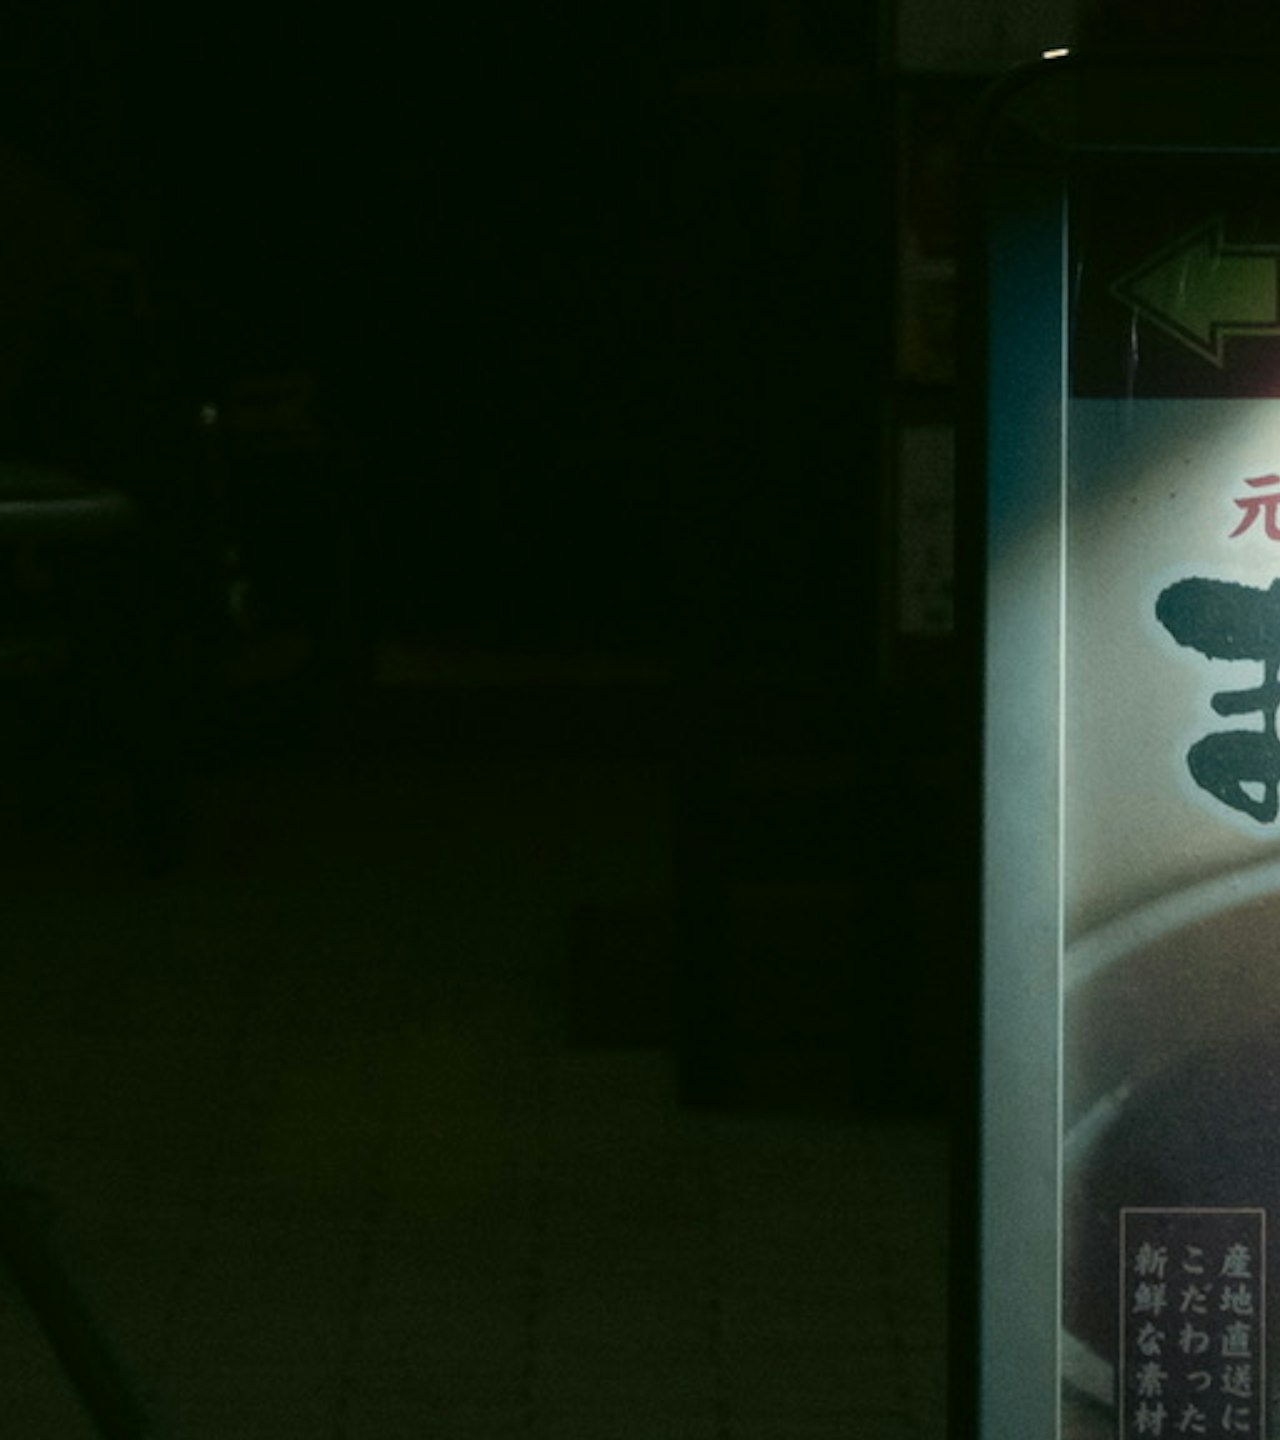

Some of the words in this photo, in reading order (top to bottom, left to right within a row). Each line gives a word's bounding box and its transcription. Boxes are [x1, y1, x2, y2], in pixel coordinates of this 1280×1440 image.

[1132, 1241, 1169, 1438] 新鮮な素材
[1179, 1244, 1212, 1434] こだわった
[1218, 1242, 1254, 1433] 産地直送に
